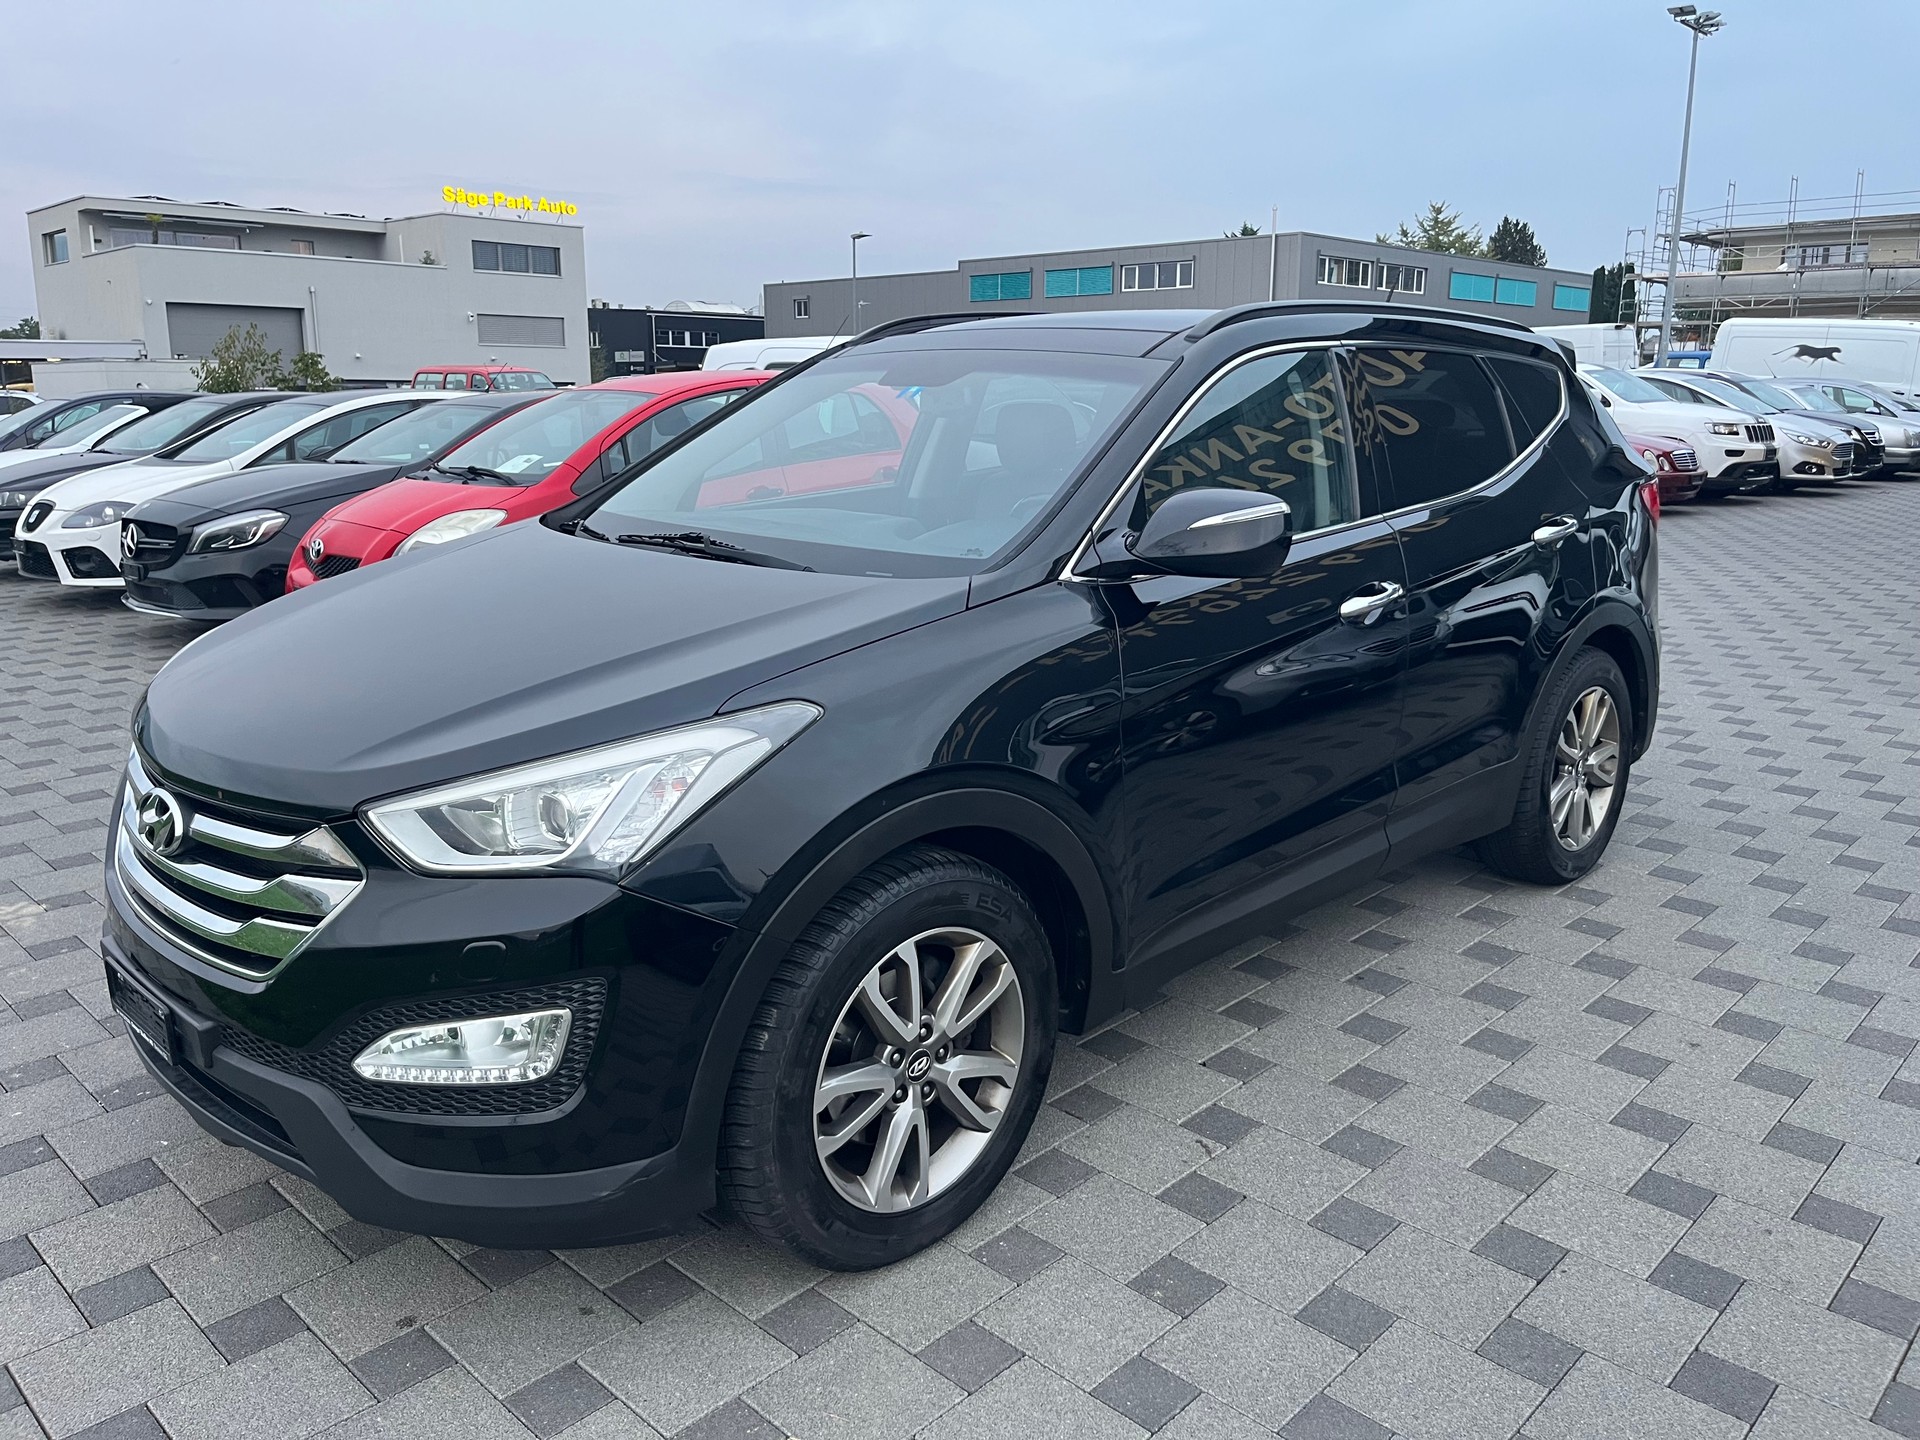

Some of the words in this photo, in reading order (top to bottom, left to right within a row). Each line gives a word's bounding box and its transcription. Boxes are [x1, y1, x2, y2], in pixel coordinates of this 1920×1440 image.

[442, 185, 489, 209] Säge
[493, 191, 534, 211] Park
[537, 197, 577, 216] Auto
